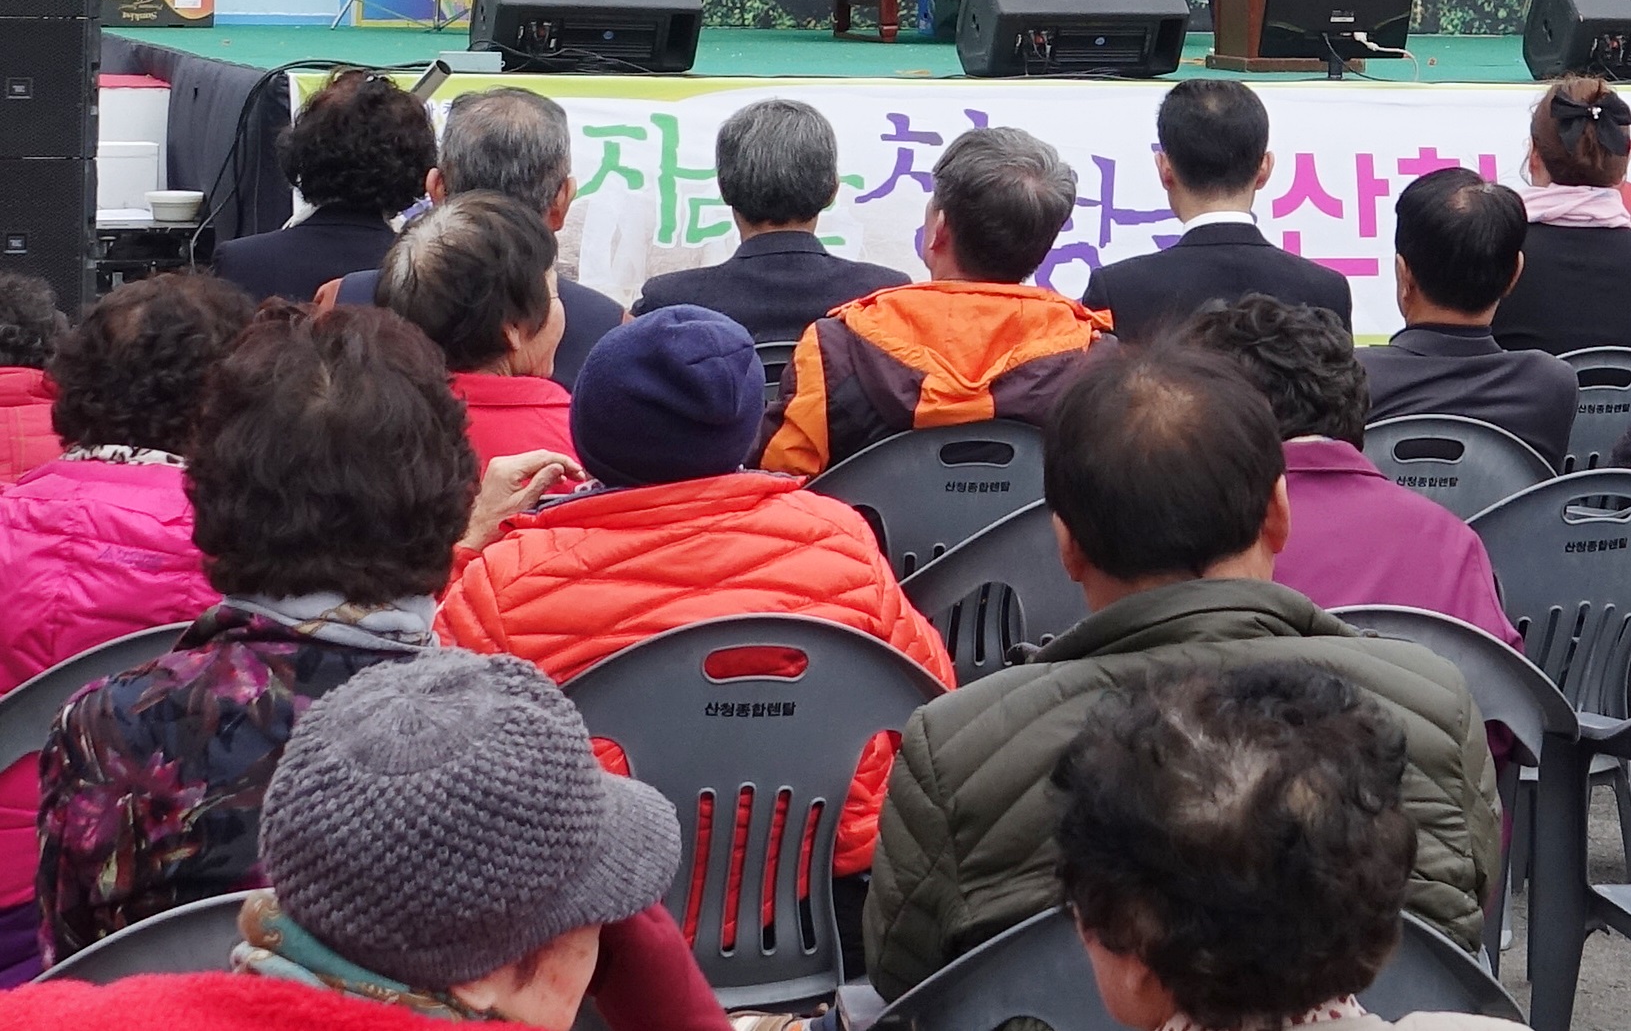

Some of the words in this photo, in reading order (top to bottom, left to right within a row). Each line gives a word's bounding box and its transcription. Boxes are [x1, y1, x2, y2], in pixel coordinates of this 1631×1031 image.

[1577, 402, 1631, 414] 산청종합렌탈
[945, 481, 1011, 493] 산청종합렌탈
[1396, 475, 1459, 488] 산청종합렌탈
[1564, 537, 1628, 553] 산청종합렌탈
[704, 701, 797, 718] 산청종합렌탈
